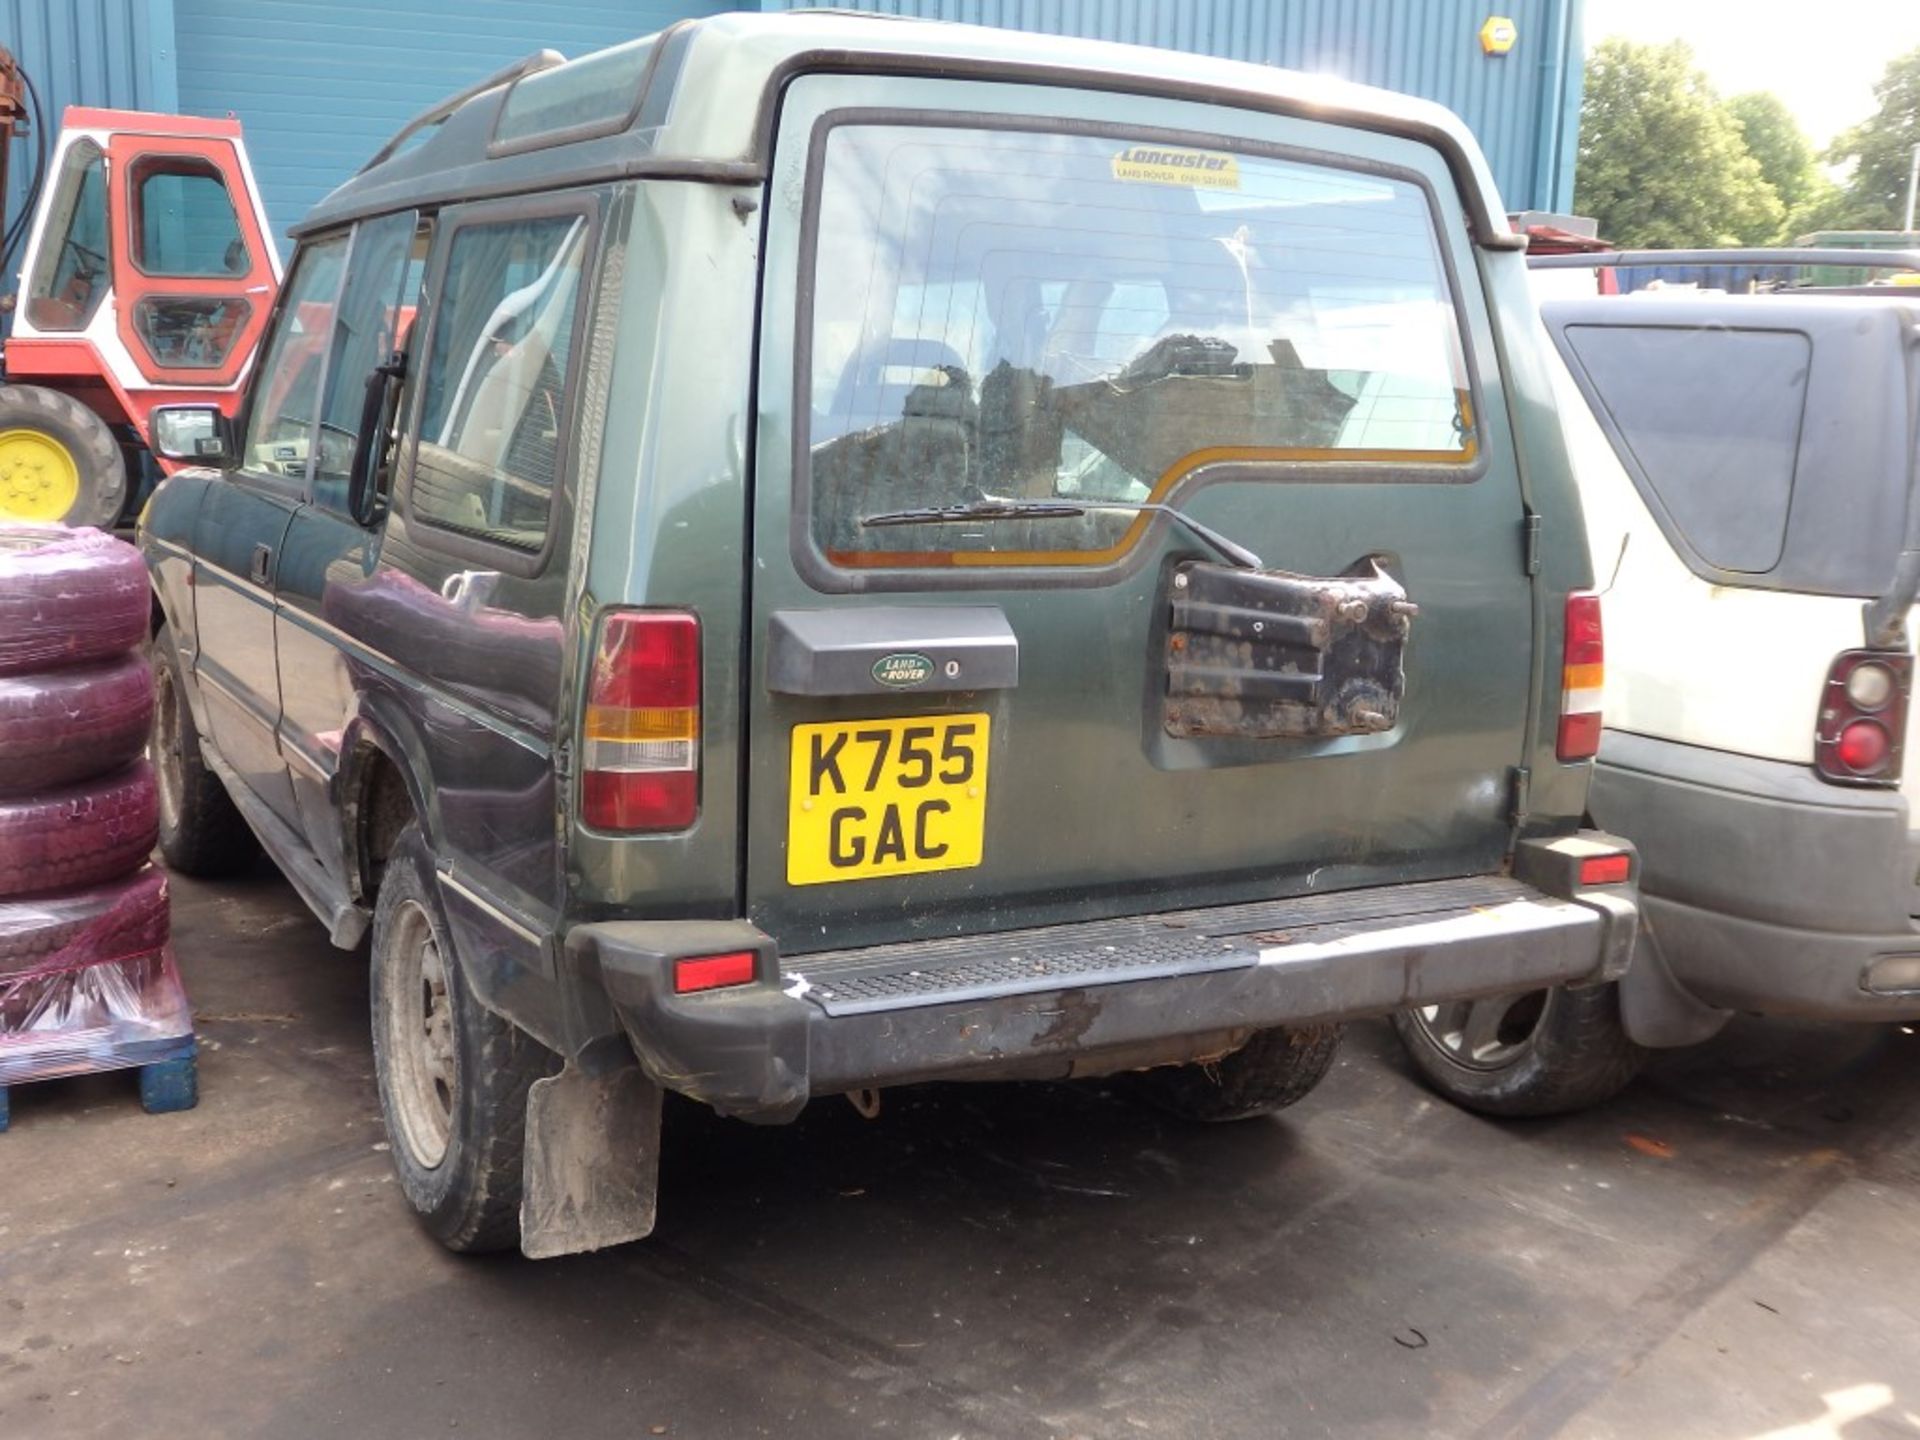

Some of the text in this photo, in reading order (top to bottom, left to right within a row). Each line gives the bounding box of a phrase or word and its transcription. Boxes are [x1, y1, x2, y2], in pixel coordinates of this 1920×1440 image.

[1120, 149, 1229, 171] Lancaster
[1143, 170, 1175, 181] ROVER
[885, 659, 916, 670] LAND
[887, 668, 925, 680] ROVER
[809, 723, 976, 796] K755
[828, 799, 951, 868] GAC
